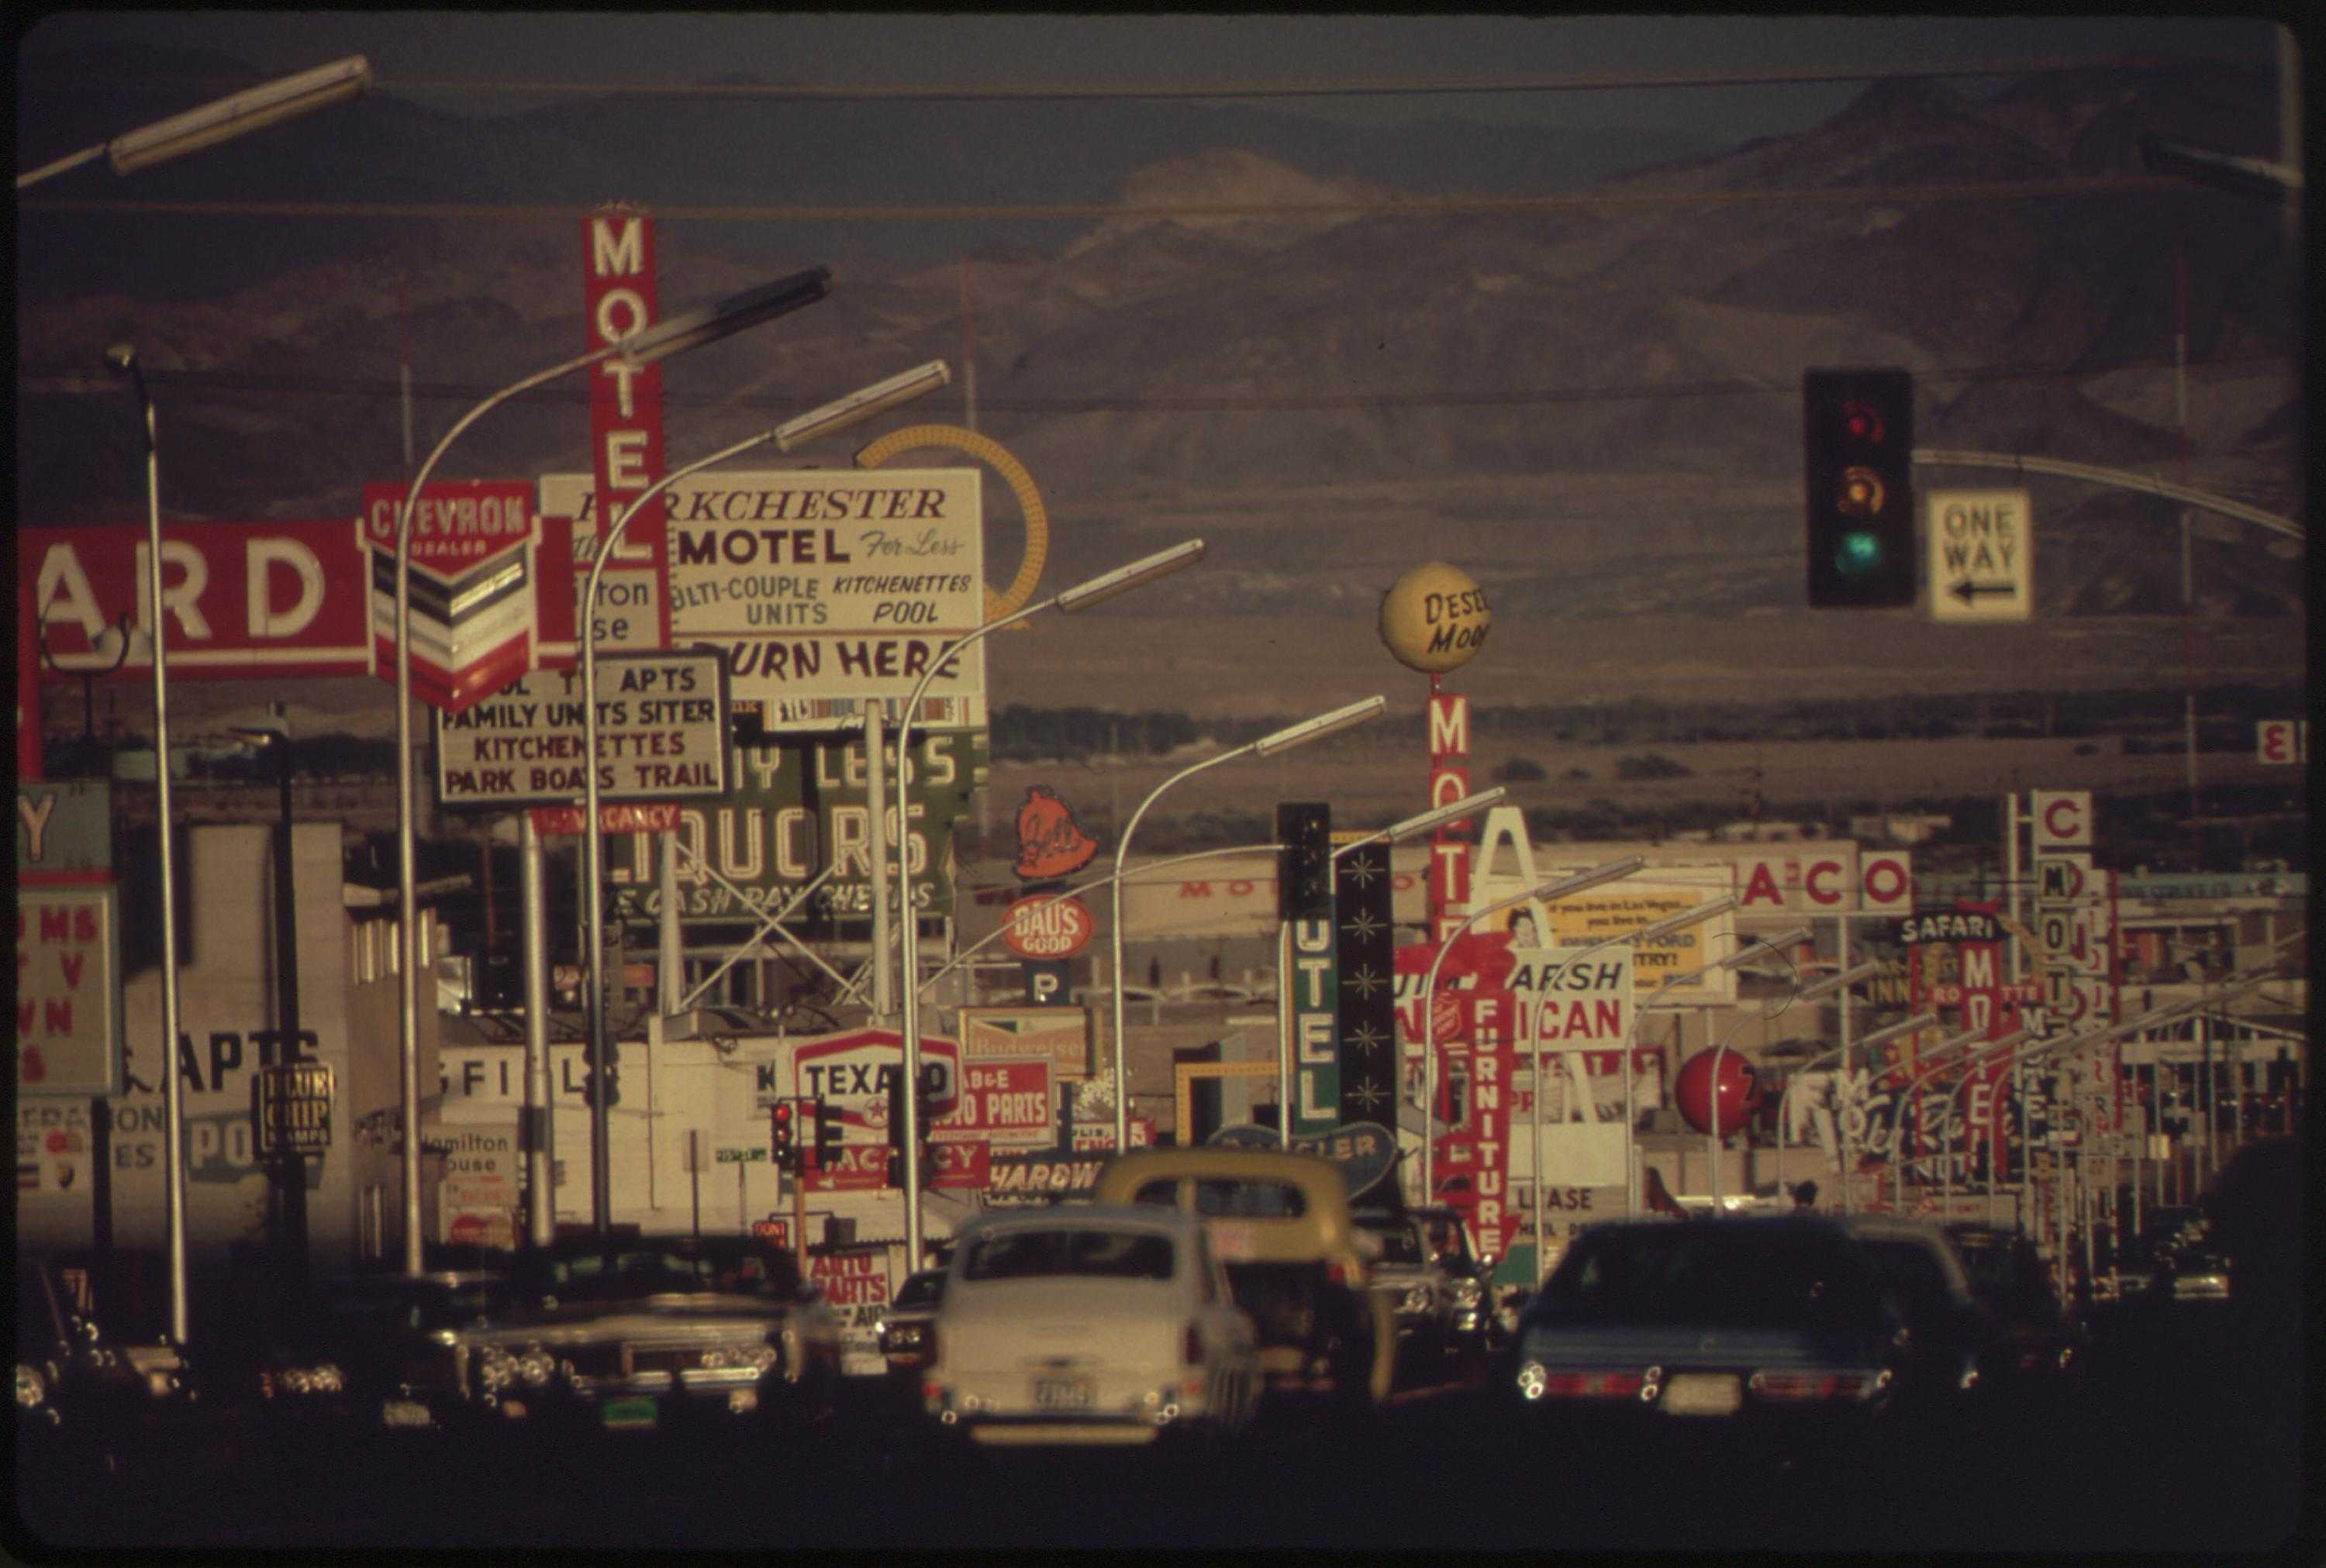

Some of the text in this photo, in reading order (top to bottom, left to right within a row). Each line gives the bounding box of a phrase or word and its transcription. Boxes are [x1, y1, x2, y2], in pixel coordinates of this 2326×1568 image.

[592, 217, 653, 560] MOTEL
[1944, 503, 2014, 539] ONE
[412, 541, 486, 557] DEALER
[678, 529, 851, 566] MOTEL
[860, 530, 902, 558] For
[1944, 544, 2015, 572] WAY
[37, 536, 325, 641] ARD
[671, 574, 971, 612] ULTI-COUPLE KITCHENETTES
[746, 601, 938, 625] UNITS POOL
[836, 639, 967, 680] HERE
[621, 667, 696, 692] APTS
[443, 700, 715, 730] FAMILY UNTS SITER
[474, 732, 685, 761] KITCHENETTES
[445, 763, 718, 794] PARK BOAS TRAIL
[1901, 915, 1994, 943] SAFARI
[1034, 974, 1058, 1001] P
[1510, 963, 1623, 992] ARSH
[806, 1062, 948, 1096] TEXAO
[986, 1091, 1047, 1125] PARTS
[1475, 999, 1505, 1254] FURNITURE
[811, 1253, 872, 1279] AUTO
